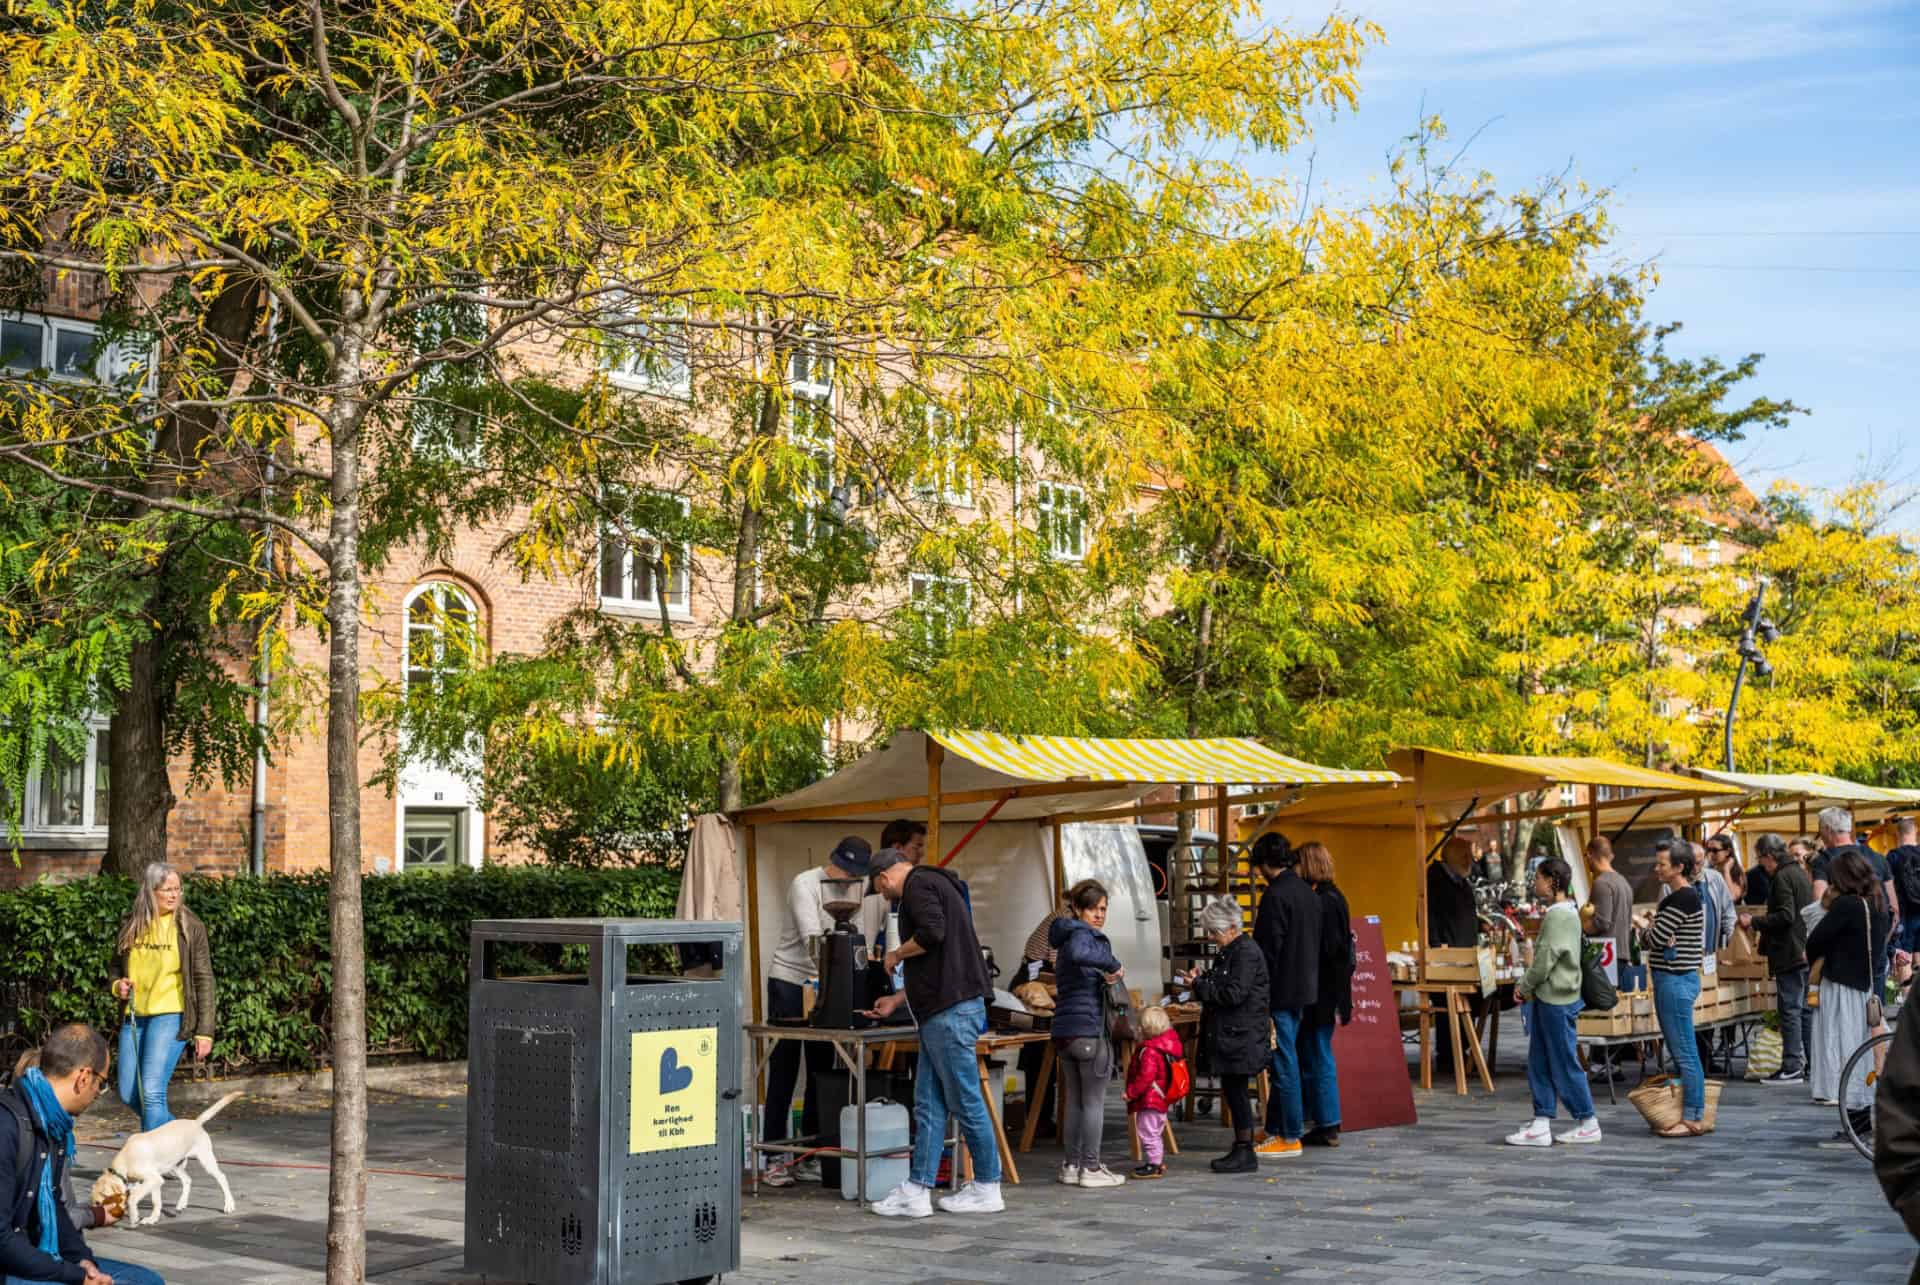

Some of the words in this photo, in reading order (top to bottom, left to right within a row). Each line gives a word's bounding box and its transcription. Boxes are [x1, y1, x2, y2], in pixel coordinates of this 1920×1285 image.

[664, 1104, 681, 1113] Ren
[653, 1115, 694, 1126] kærlighed
[659, 1128, 668, 1137] til
[669, 1127, 685, 1137] Kbh
